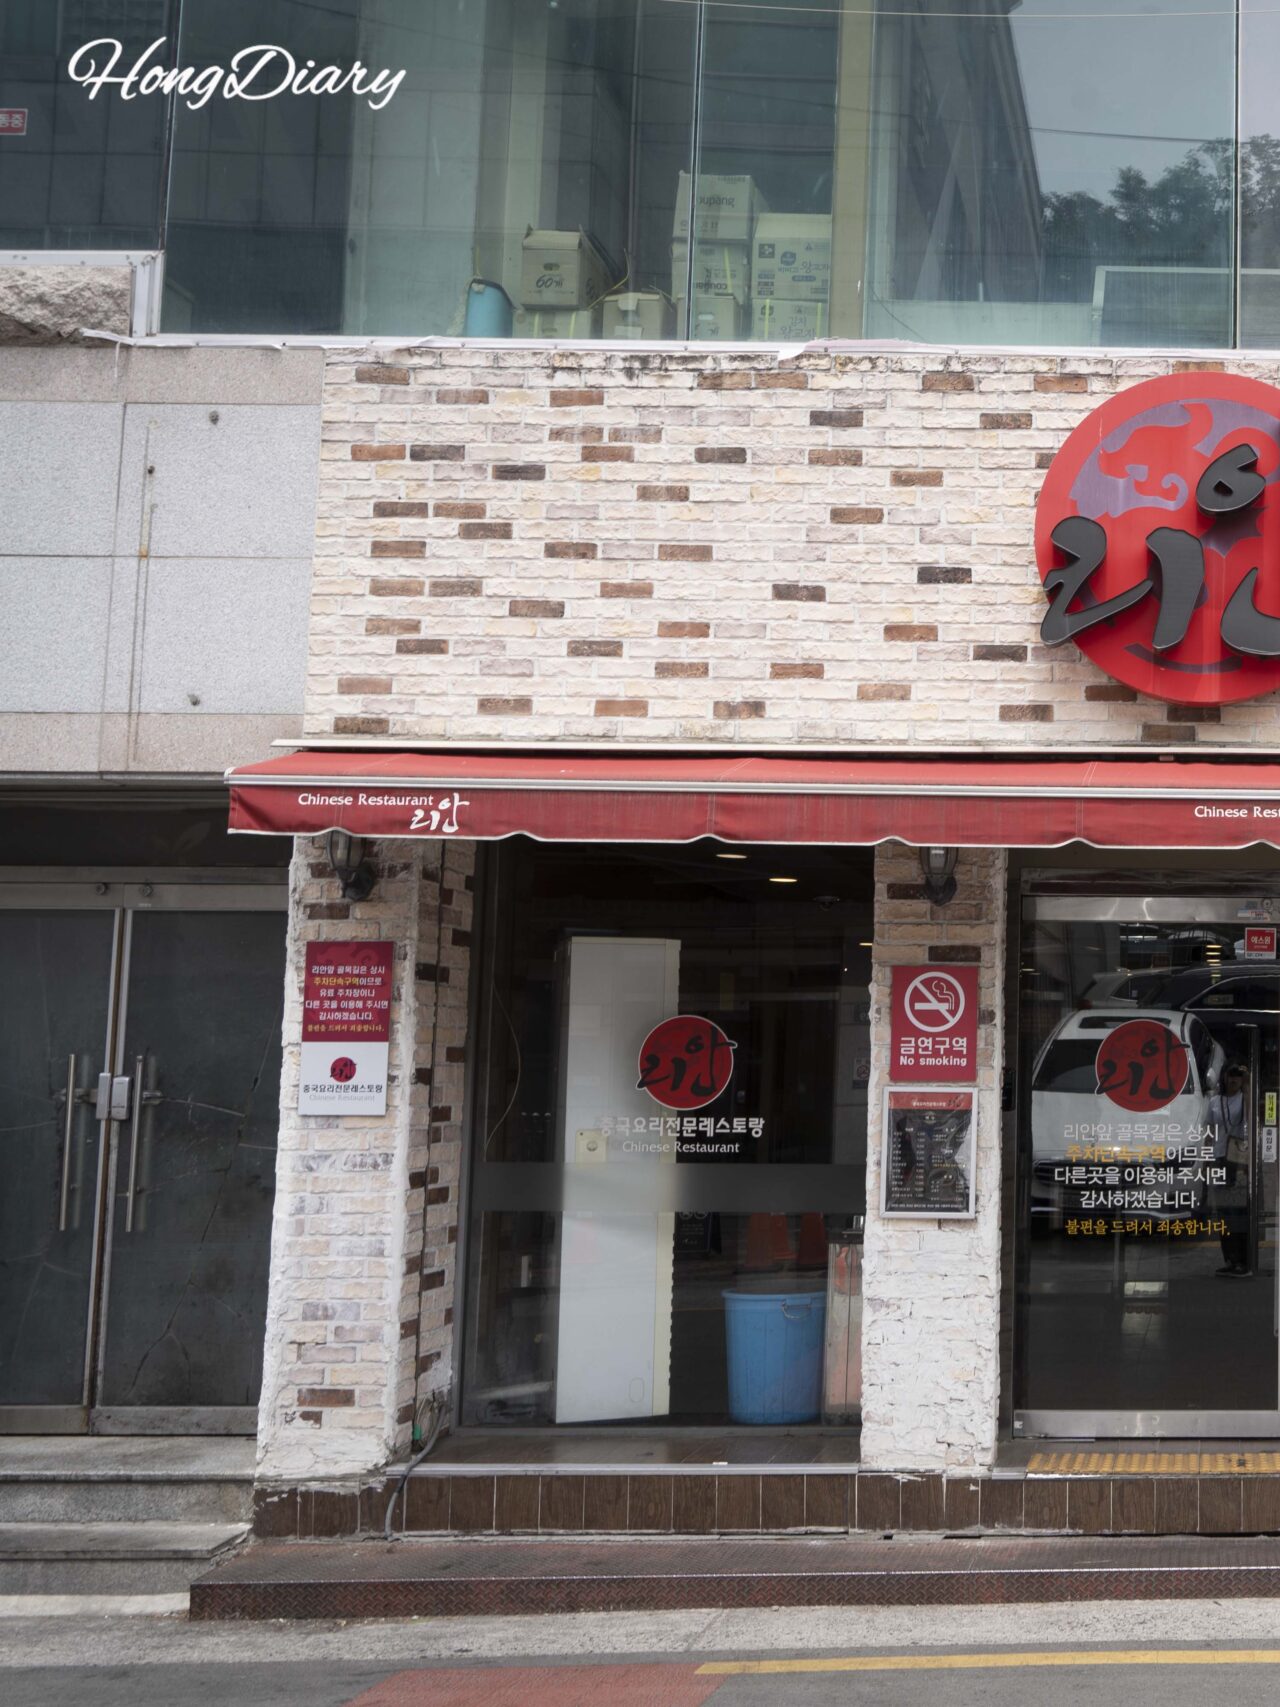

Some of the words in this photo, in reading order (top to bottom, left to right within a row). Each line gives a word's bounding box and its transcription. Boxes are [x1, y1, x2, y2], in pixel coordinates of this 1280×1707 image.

[298, 793, 353, 806] Chinese
[358, 793, 433, 806] Restaurant
[1194, 806, 1248, 818] Chinese
[370, 965, 385, 974] 상시
[900, 1037, 967, 1054] 금연구역
[900, 1056, 915, 1066] No
[920, 1056, 967, 1067] smoking
[600, 1117, 765, 1138] 중국요리전문레스토랑
[1063, 1123, 1112, 1141] 리안앞
[1116, 1123, 1182, 1141] 골목길은
[1187, 1123, 1219, 1141] 상시
[622, 1141, 669, 1153] Chinese
[674, 1141, 740, 1153] Restaurant
[1065, 1145, 1216, 1162] 주차단속구역이므로
[1054, 1167, 1121, 1184] 다른곳을
[1124, 1167, 1174, 1184] 이용해
[1177, 1167, 1227, 1185] 주시면
[1080, 1190, 1200, 1208] 감사하겠습니다.
[1065, 1219, 1108, 1235] 불편을
[1111, 1219, 1152, 1235] 드려서
[1157, 1219, 1230, 1236] 죄송합니다.
